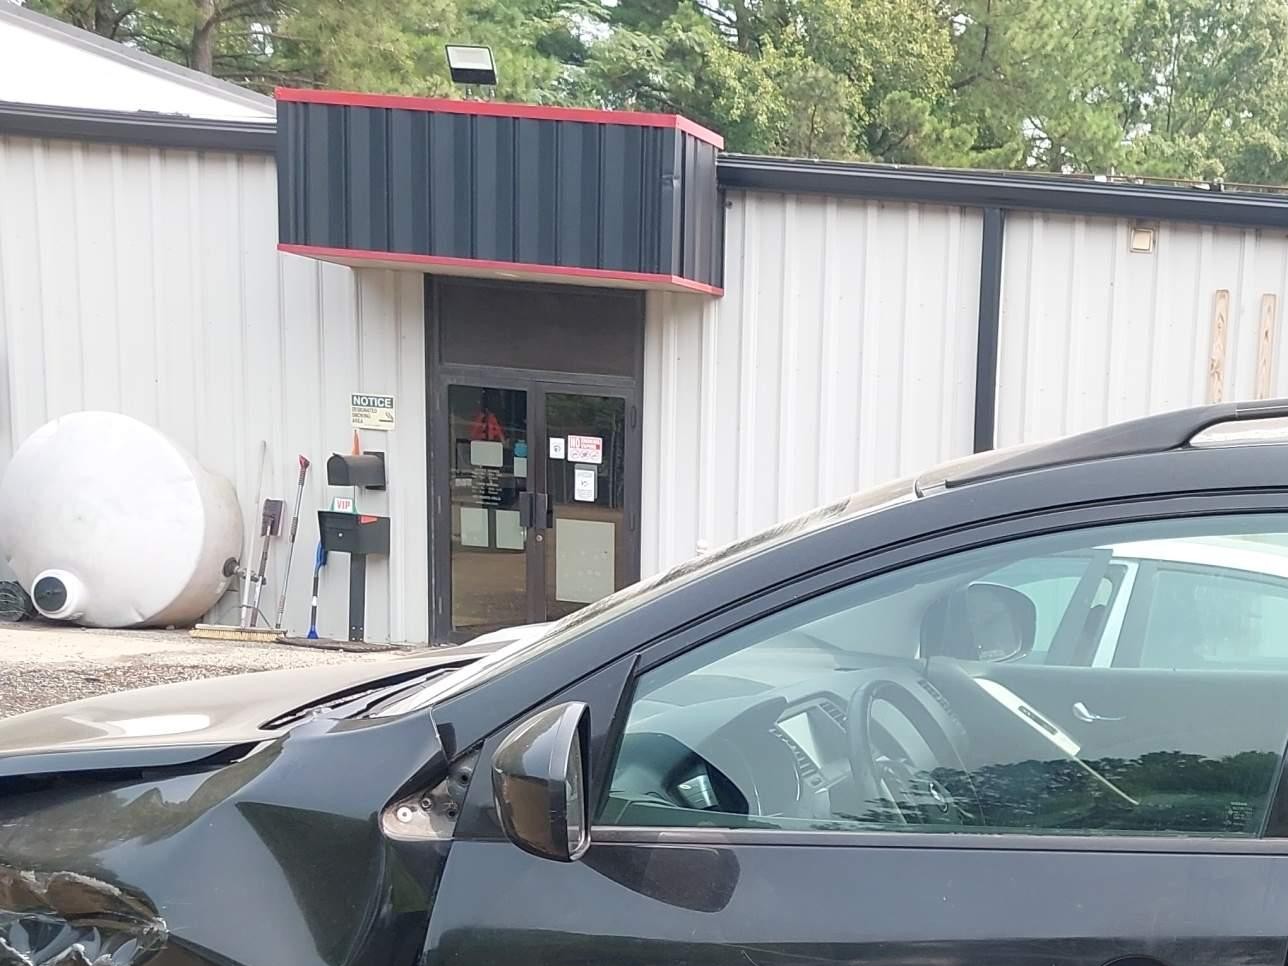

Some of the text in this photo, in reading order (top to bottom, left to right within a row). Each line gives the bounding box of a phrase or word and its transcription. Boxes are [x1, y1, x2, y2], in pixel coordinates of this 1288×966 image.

[353, 396, 392, 408] NOTICE
[570, 437, 581, 448] NO
[337, 500, 351, 510] VIP
